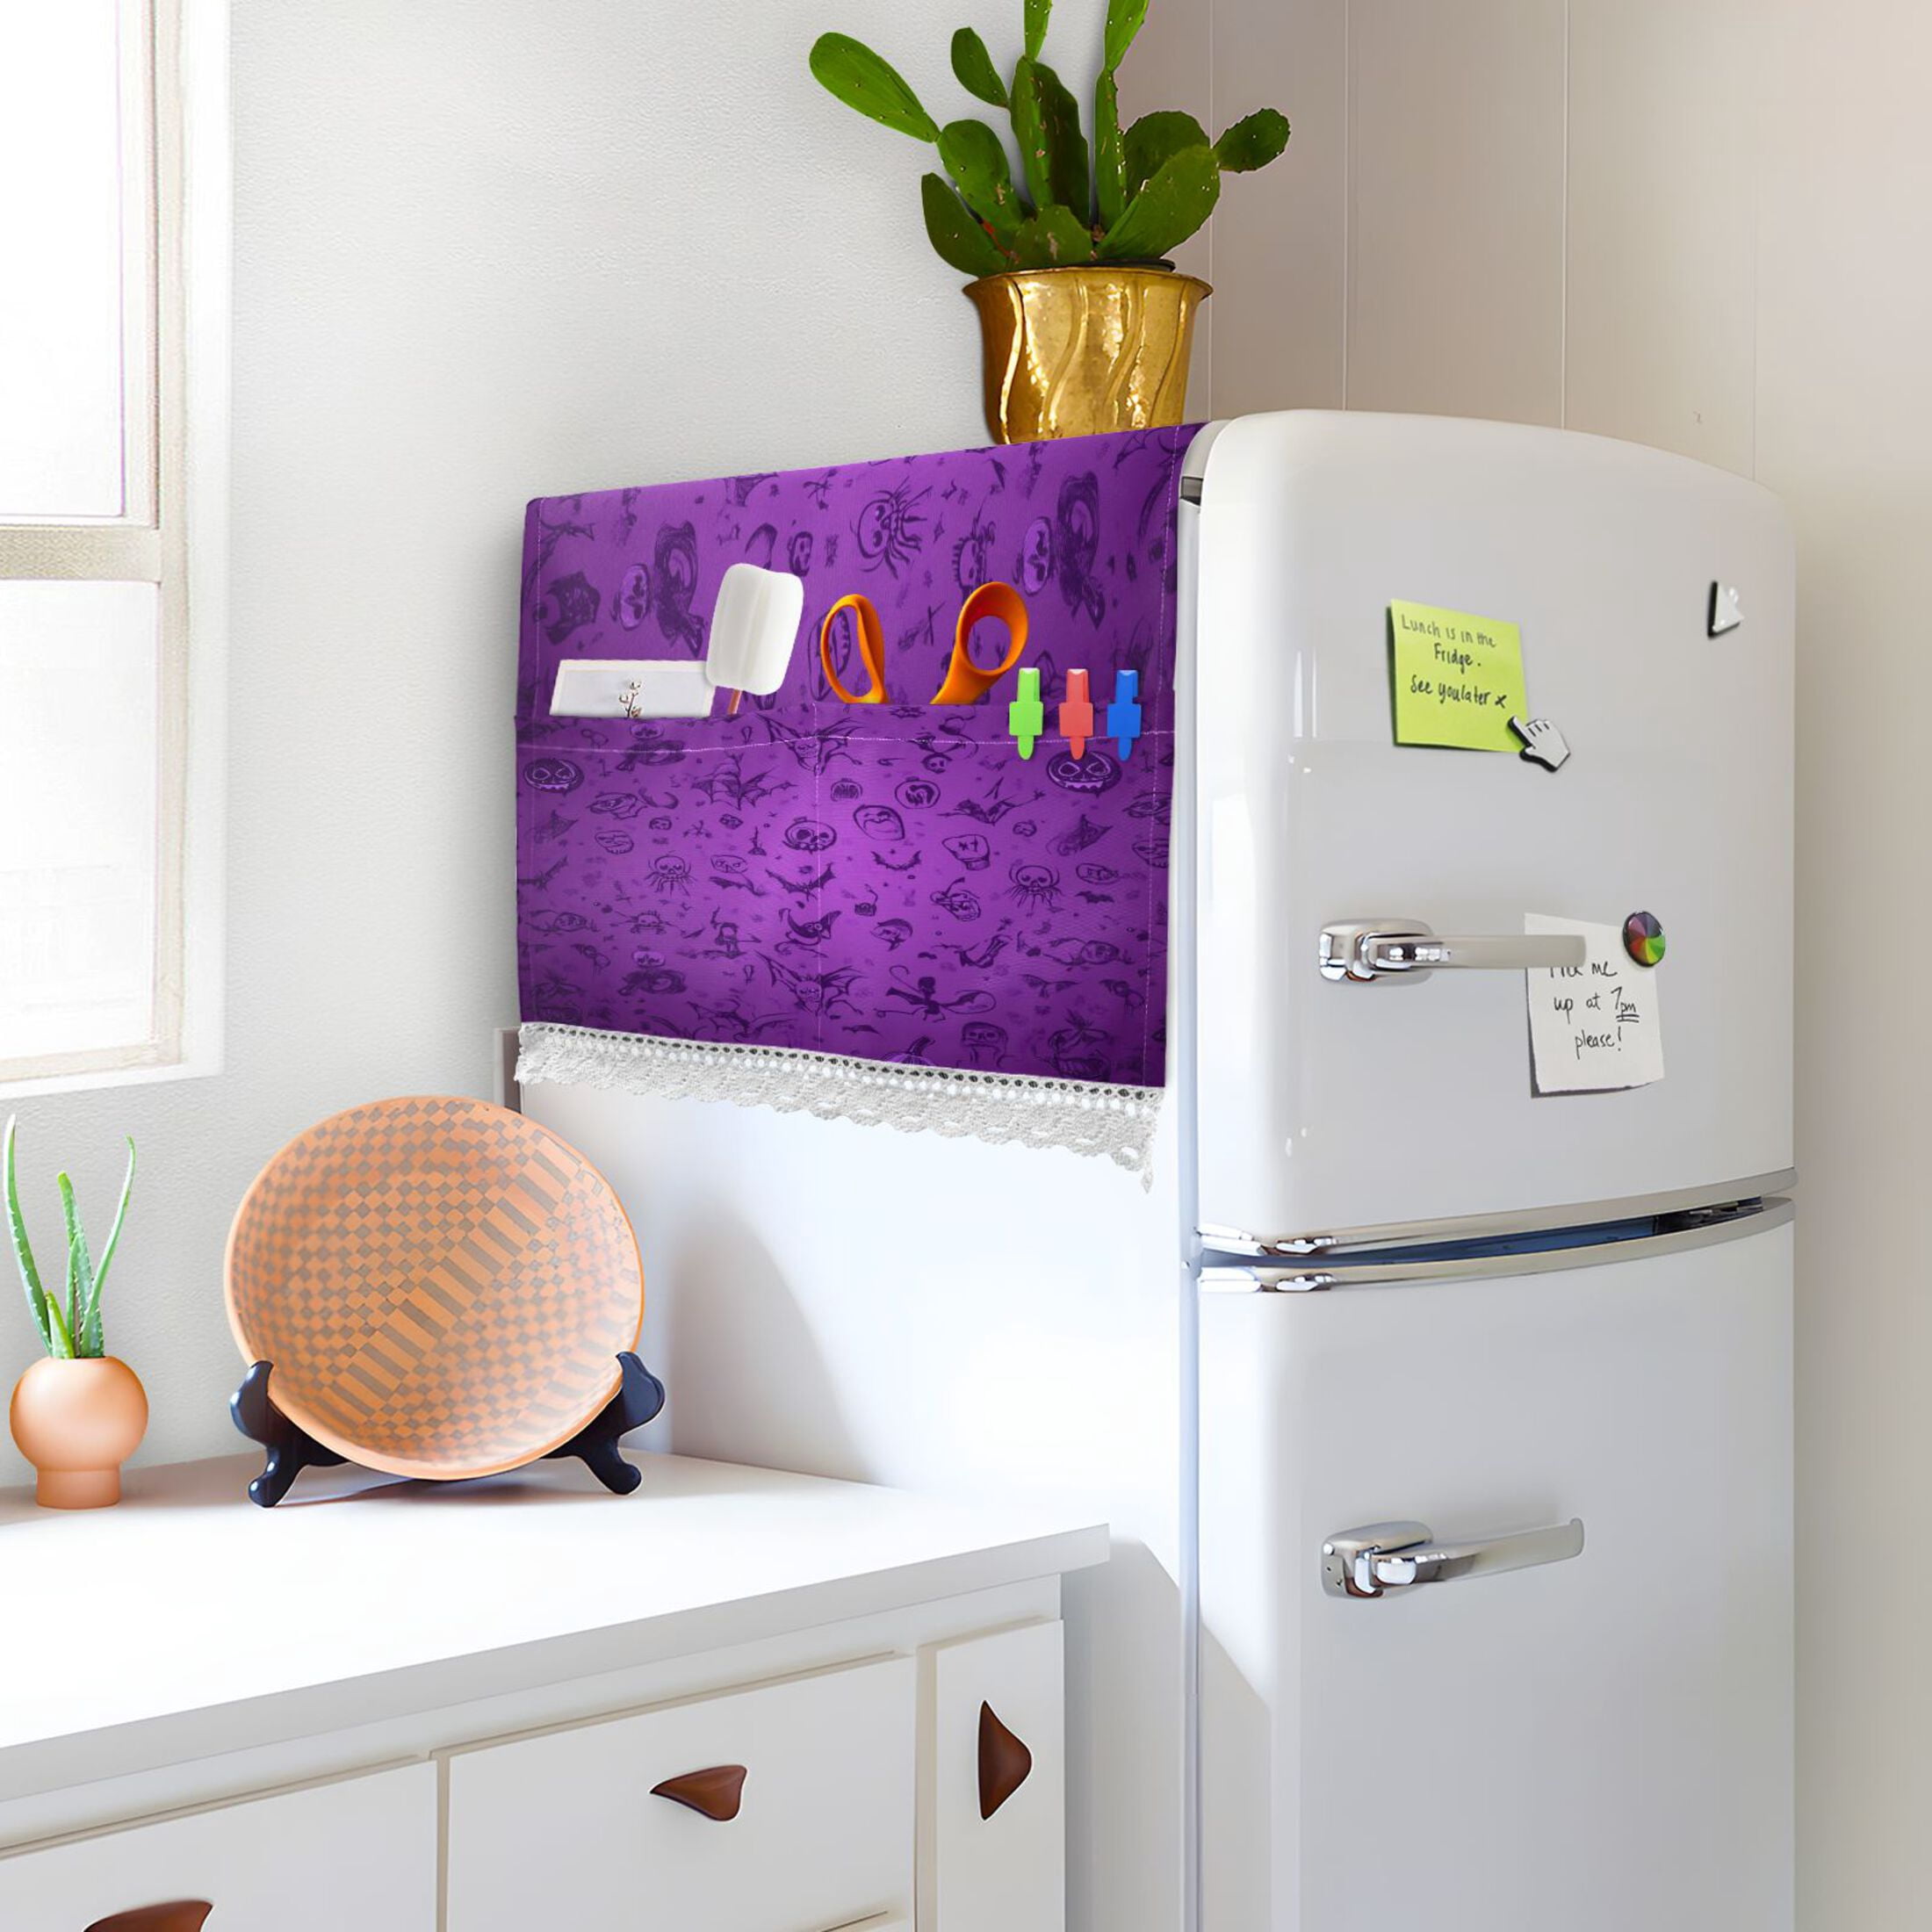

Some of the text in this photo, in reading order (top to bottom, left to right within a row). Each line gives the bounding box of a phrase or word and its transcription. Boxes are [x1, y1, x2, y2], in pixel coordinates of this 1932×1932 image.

[1402, 614, 1440, 638] Lunch
[1477, 633, 1496, 647] the
[1411, 674, 1433, 695] See
[1591, 962, 1618, 977] me
[1554, 998, 1574, 1024] up
[1586, 991, 1601, 1011] at
[1575, 1026, 1622, 1060] please!
